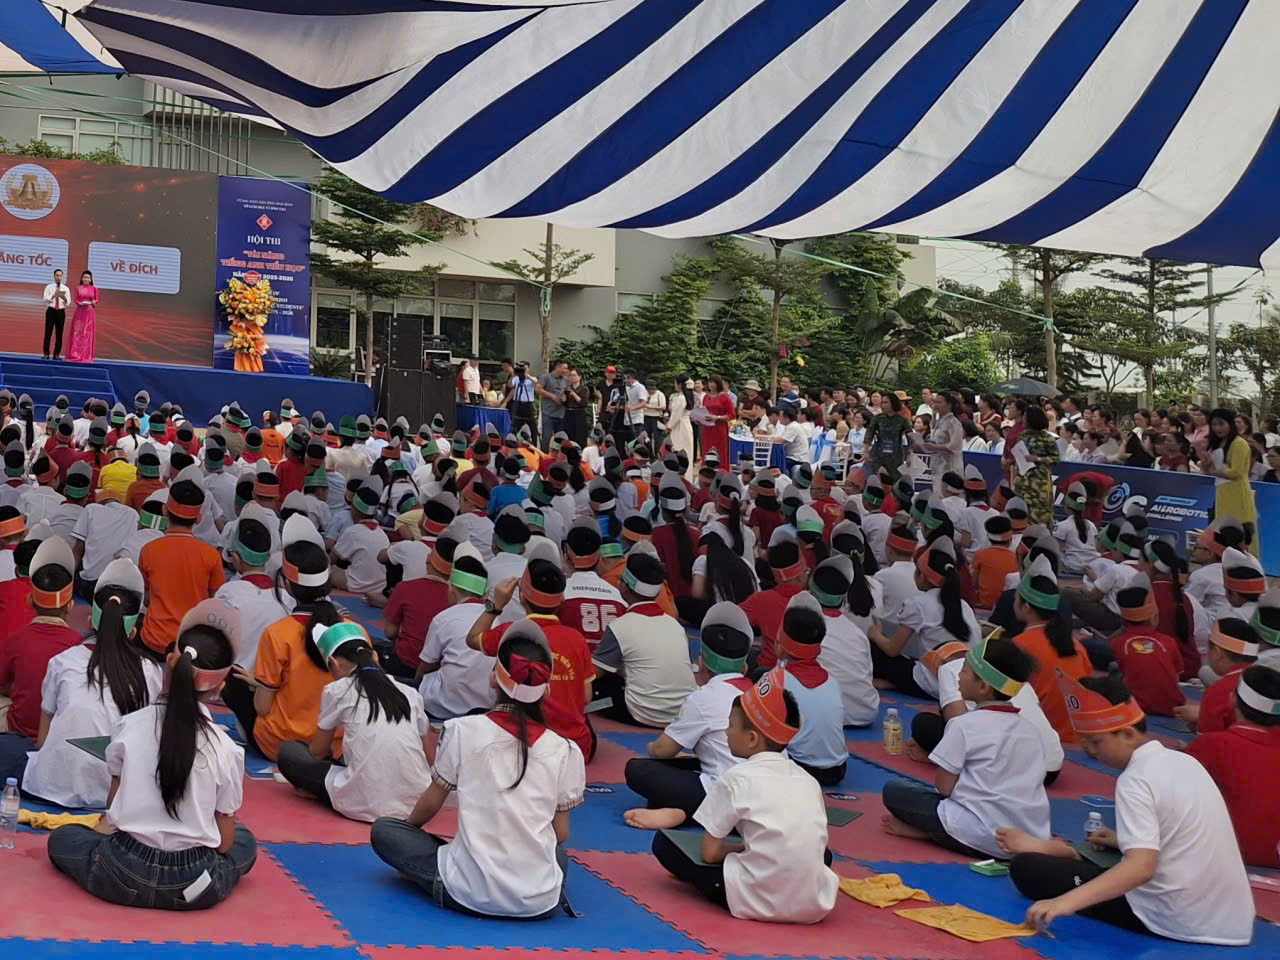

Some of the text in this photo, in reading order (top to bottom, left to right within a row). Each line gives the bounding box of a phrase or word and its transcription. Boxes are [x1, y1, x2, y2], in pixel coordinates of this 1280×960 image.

[247, 234, 280, 245] HỘI THI
[28, 252, 52, 267] TỐC
[110, 259, 158, 275] VỀ ĐÍCH
[1146, 512, 1183, 522] CHALLENGE
[1150, 504, 1208, 519] AI&ROBOTIC
